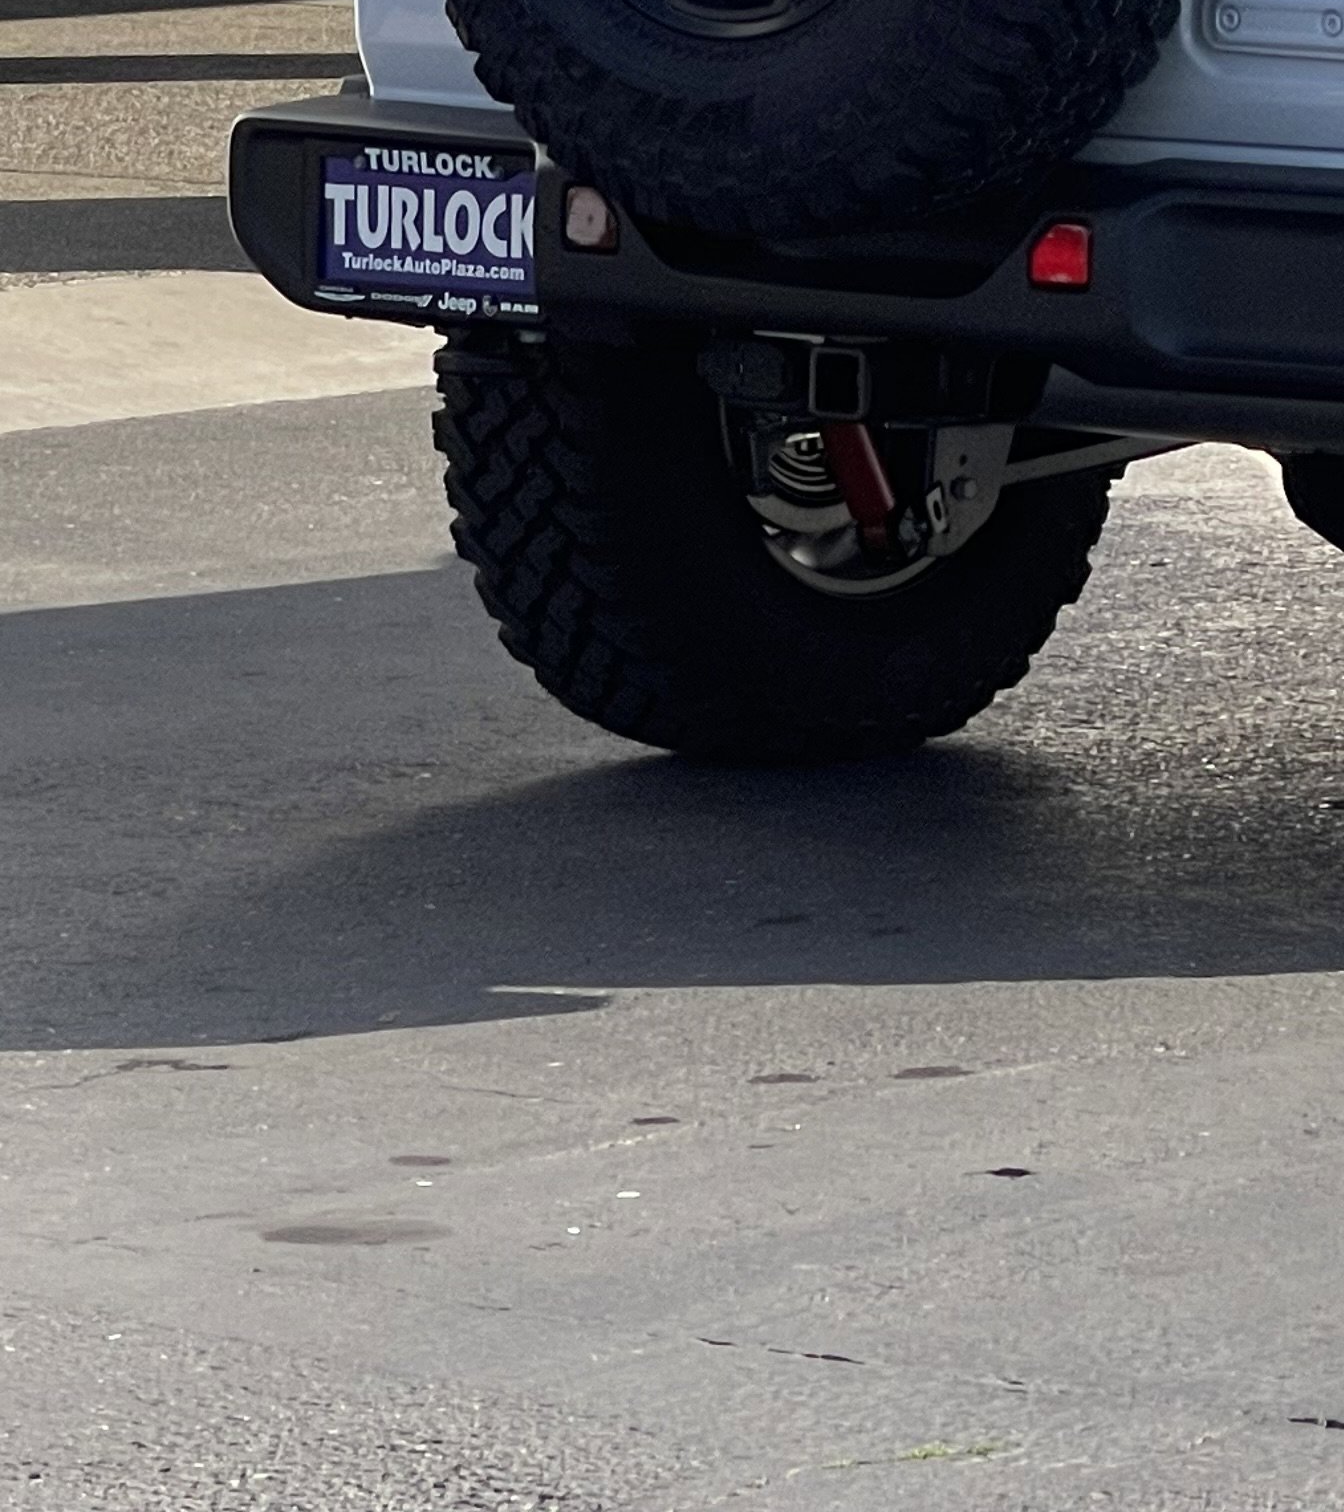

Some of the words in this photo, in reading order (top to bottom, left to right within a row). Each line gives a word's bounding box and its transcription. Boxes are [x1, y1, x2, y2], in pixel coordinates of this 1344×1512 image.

[364, 147, 493, 179] TURLOCK
[324, 183, 534, 258] TURLOCK
[342, 251, 525, 281] TurlockAutoPlaza.com
[437, 291, 477, 315] Jeep
